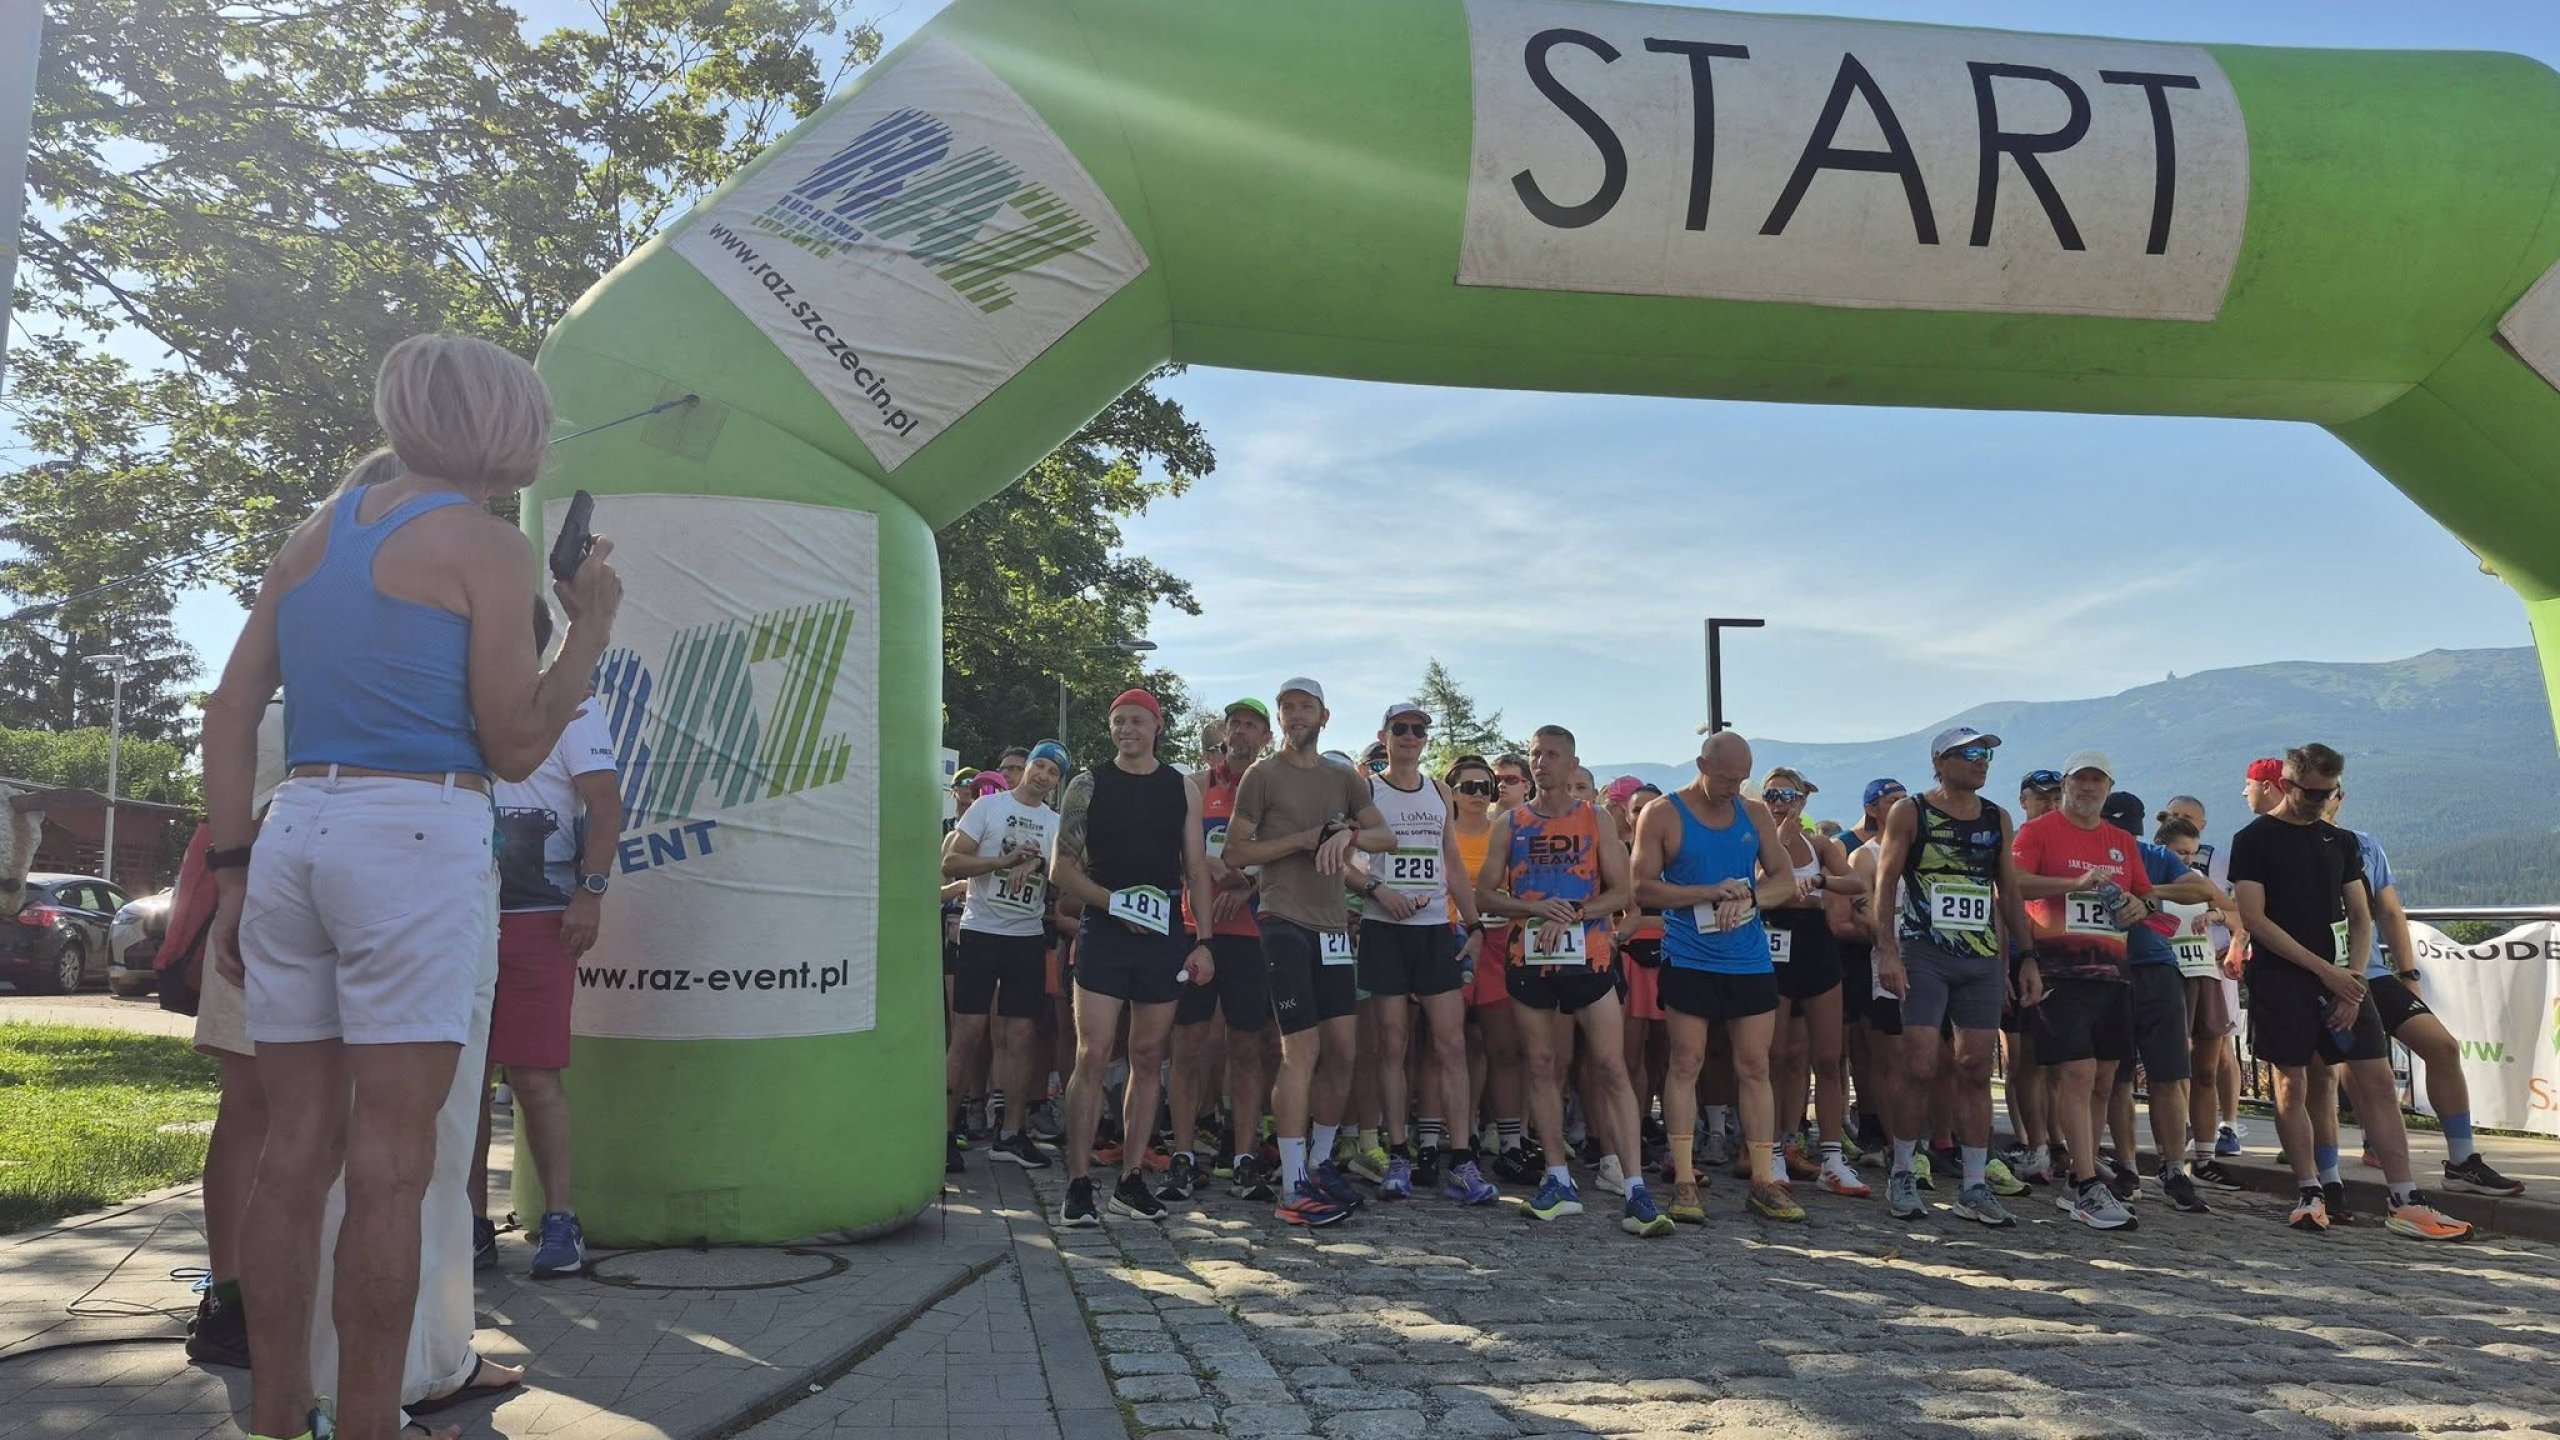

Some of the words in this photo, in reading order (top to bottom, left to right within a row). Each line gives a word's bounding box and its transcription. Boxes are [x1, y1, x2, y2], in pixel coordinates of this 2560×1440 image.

[1511, 27, 2200, 255] START
[709, 223, 919, 438] www.raz.szczecin.pl
[1529, 834, 1580, 854] EDI
[1394, 858, 1434, 879] 229
[1529, 854, 1581, 865] TEAM
[1121, 893, 1161, 920] 181
[1942, 896, 1985, 920] 298
[2076, 902, 2112, 926] 12
[2170, 944, 2204, 961] 44
